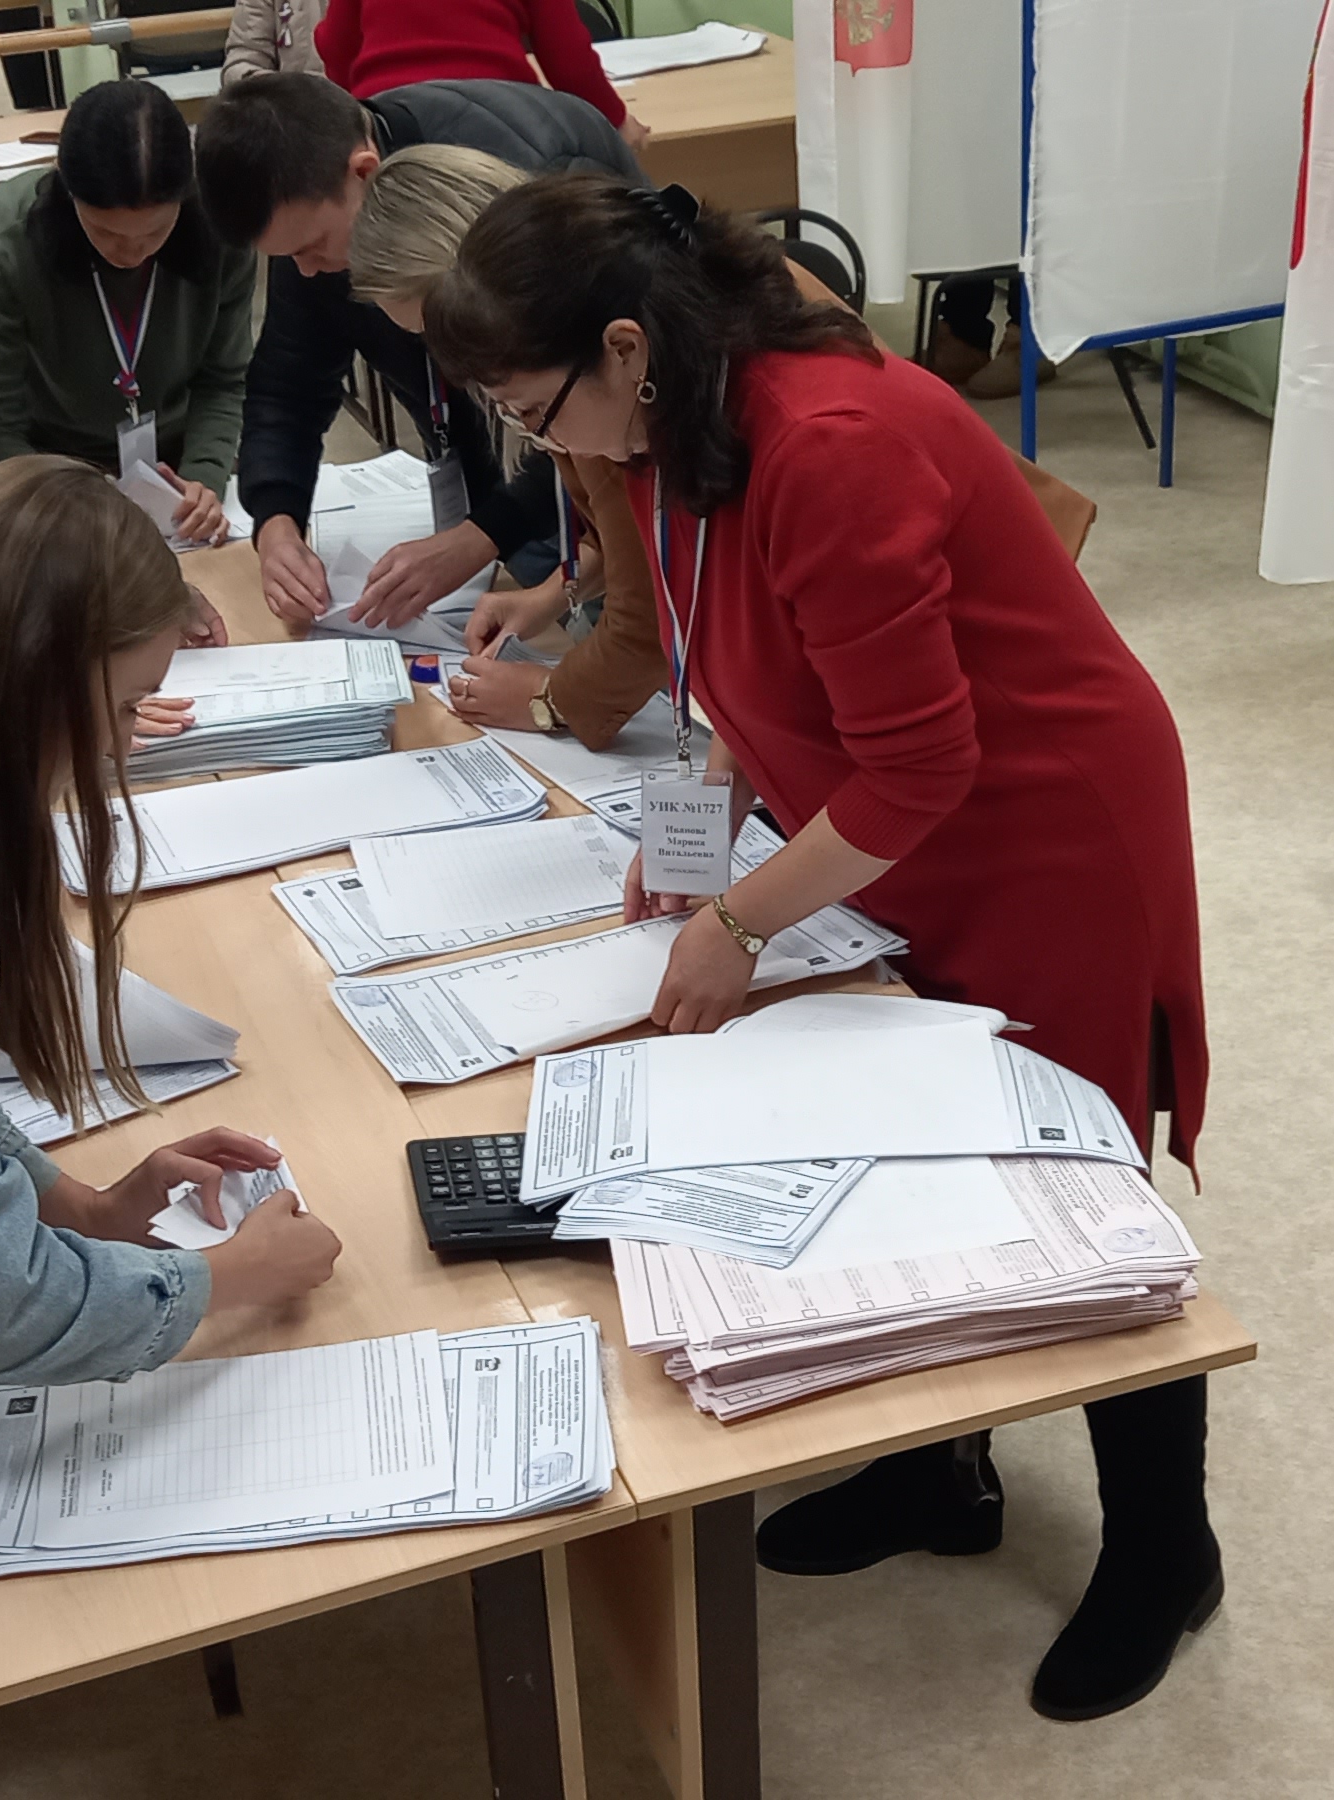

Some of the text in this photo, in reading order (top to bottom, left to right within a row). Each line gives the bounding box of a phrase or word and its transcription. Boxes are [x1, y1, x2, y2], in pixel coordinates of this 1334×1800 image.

[649, 801, 723, 814] УИК №1727
[665, 825, 706, 835] Иванова
[667, 836, 705, 847] Марина
